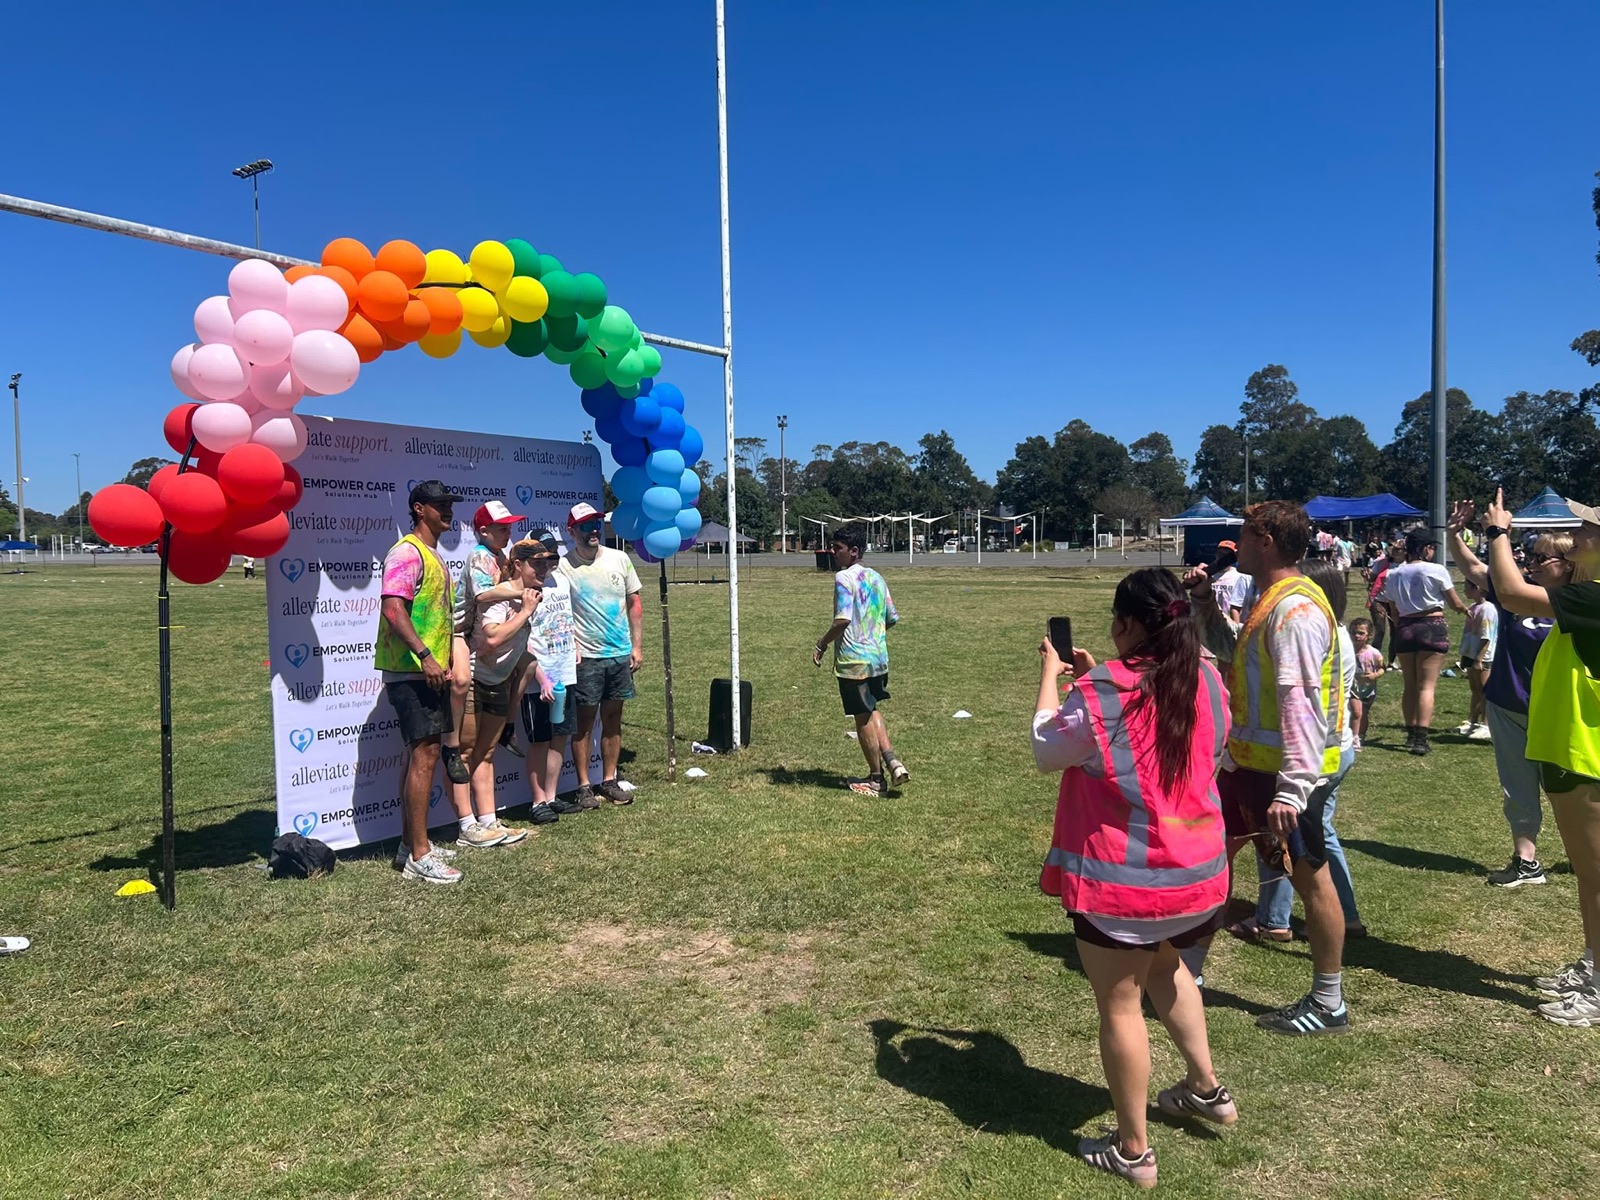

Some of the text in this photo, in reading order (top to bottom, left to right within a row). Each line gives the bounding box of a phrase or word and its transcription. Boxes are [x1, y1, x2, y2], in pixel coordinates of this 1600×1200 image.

[306, 428, 393, 454] iate support.
[405, 438, 504, 463] alleviate support.
[325, 454, 337, 462] Walk
[338, 455, 360, 463] Together
[513, 447, 596, 469] alleviate support.
[303, 478, 396, 492] EMPOWER CARE
[446, 485, 507, 497] POWER CARE
[535, 490, 599, 500] EMPOWER CARE
[286, 510, 337, 530] lleviate
[339, 515, 398, 535] support.
[344, 537, 365, 545] Together
[308, 561, 384, 573] EMPOWER CA
[282, 596, 382, 616] alleviate suppo
[321, 620, 333, 628] Let's
[347, 619, 368, 628] Together
[312, 642, 372, 657] EMPOWER
[333, 655, 369, 663] Solutions
[287, 677, 382, 701] alleviate supp
[325, 700, 373, 711] Let's Walk Together
[317, 719, 400, 740] EMPOWER CAR
[337, 735, 373, 745] Solutions
[590, 753, 601, 763] CA
[291, 753, 404, 787] alleviate support
[495, 771, 520, 784] CARE
[321, 802, 380, 824] EMPOWER
[342, 811, 393, 828] Solutions Hub
